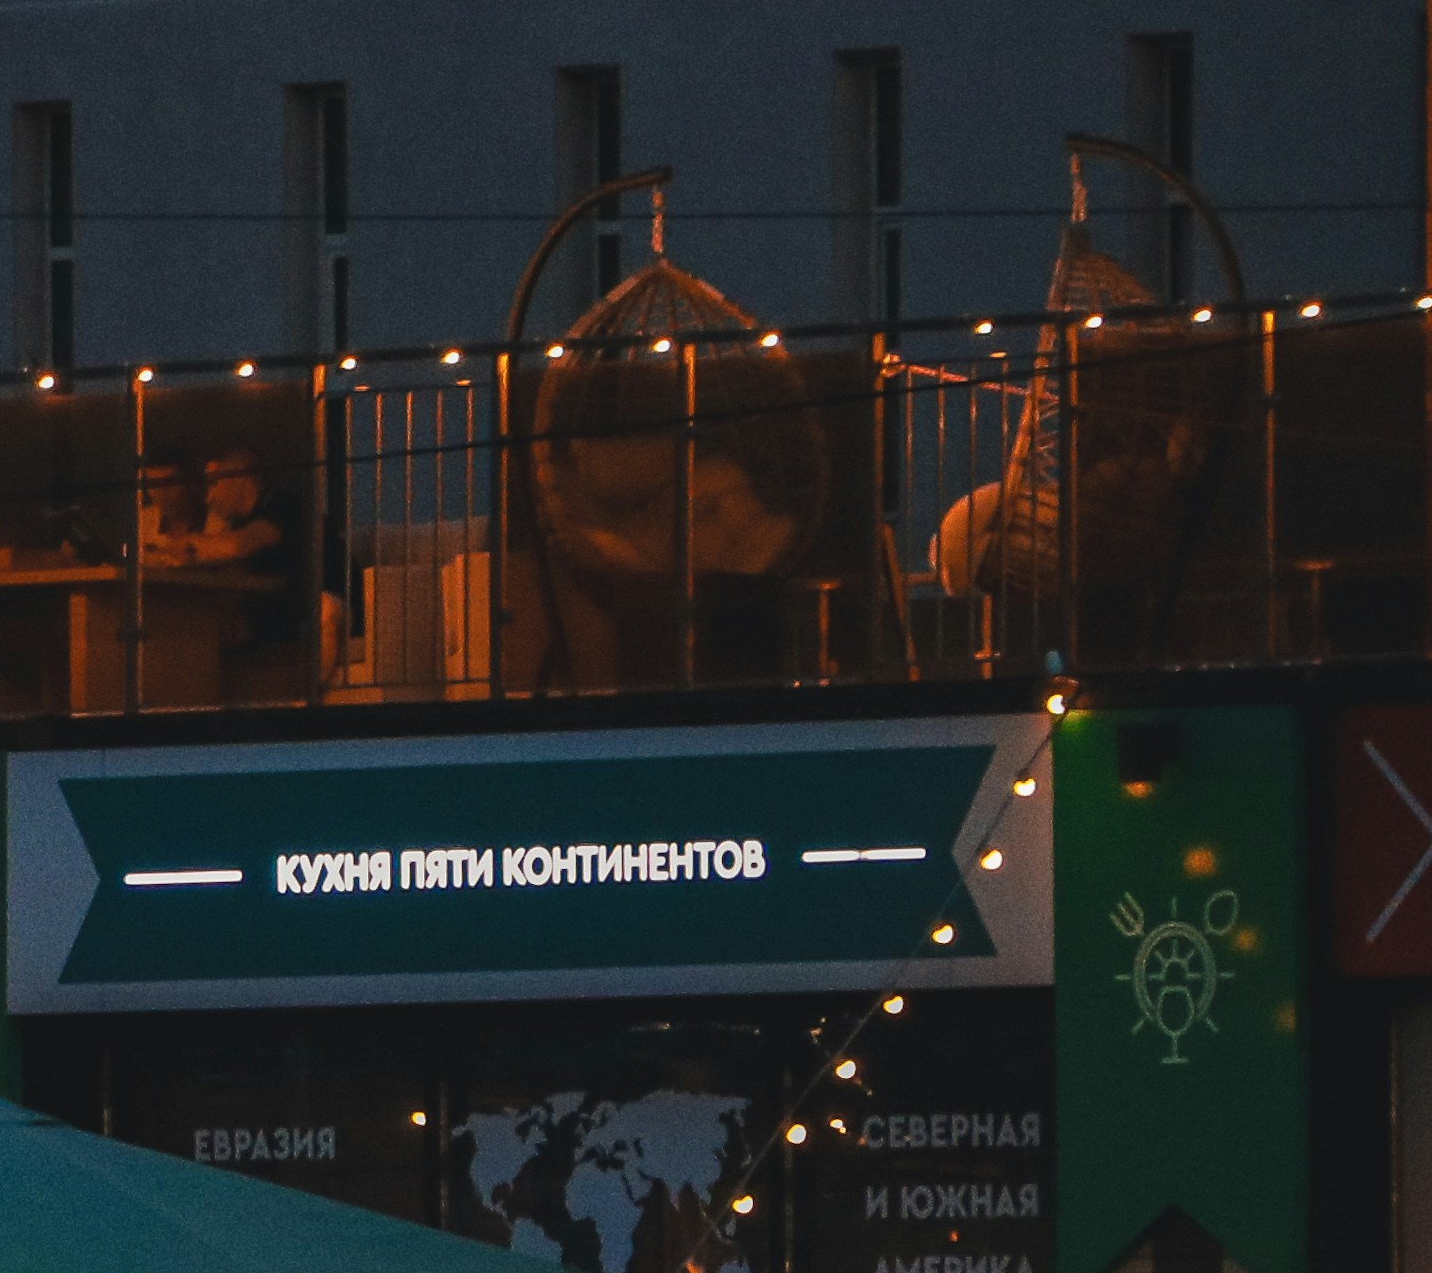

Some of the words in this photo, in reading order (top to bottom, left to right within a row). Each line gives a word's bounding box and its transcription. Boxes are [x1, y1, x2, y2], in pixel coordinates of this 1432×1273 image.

[276, 851, 391, 894] КУХНЯ
[401, 848, 495, 890] ПЯТИ
[503, 840, 767, 886] КОНТИНЕНТОВ
[194, 1127, 336, 1161] ЕВРАЗИЯ
[862, 1112, 1041, 1149] СЕВЕРНАЯ
[866, 1185, 888, 1220] И
[901, 1183, 1040, 1220] ЮЖНАЯ
